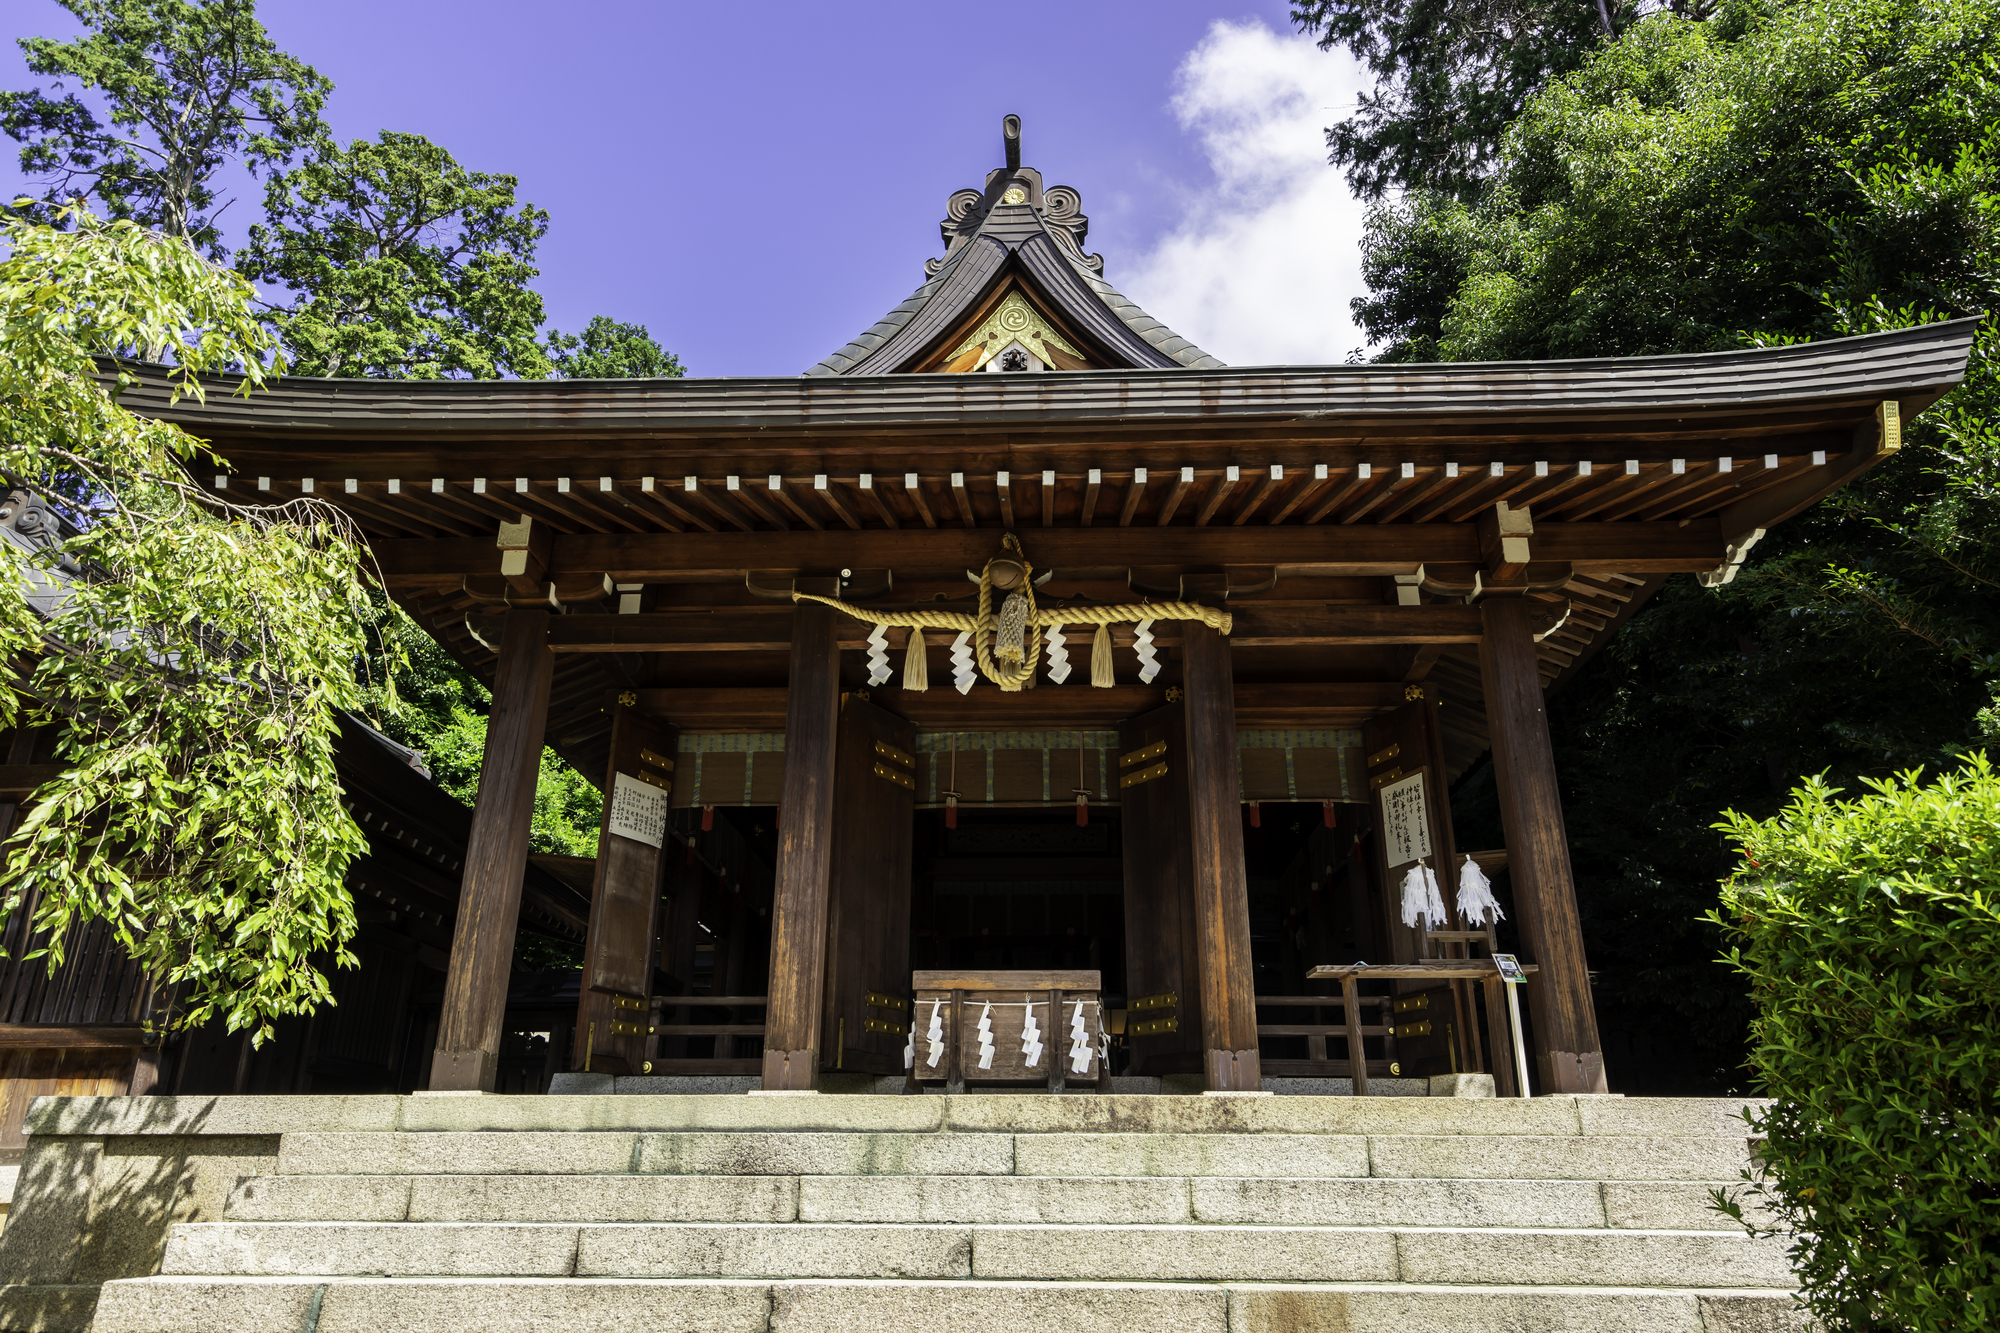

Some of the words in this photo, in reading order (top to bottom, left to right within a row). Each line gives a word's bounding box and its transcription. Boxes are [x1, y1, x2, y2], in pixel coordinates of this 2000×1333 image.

[1385, 794, 1393, 836] いたしましょう
